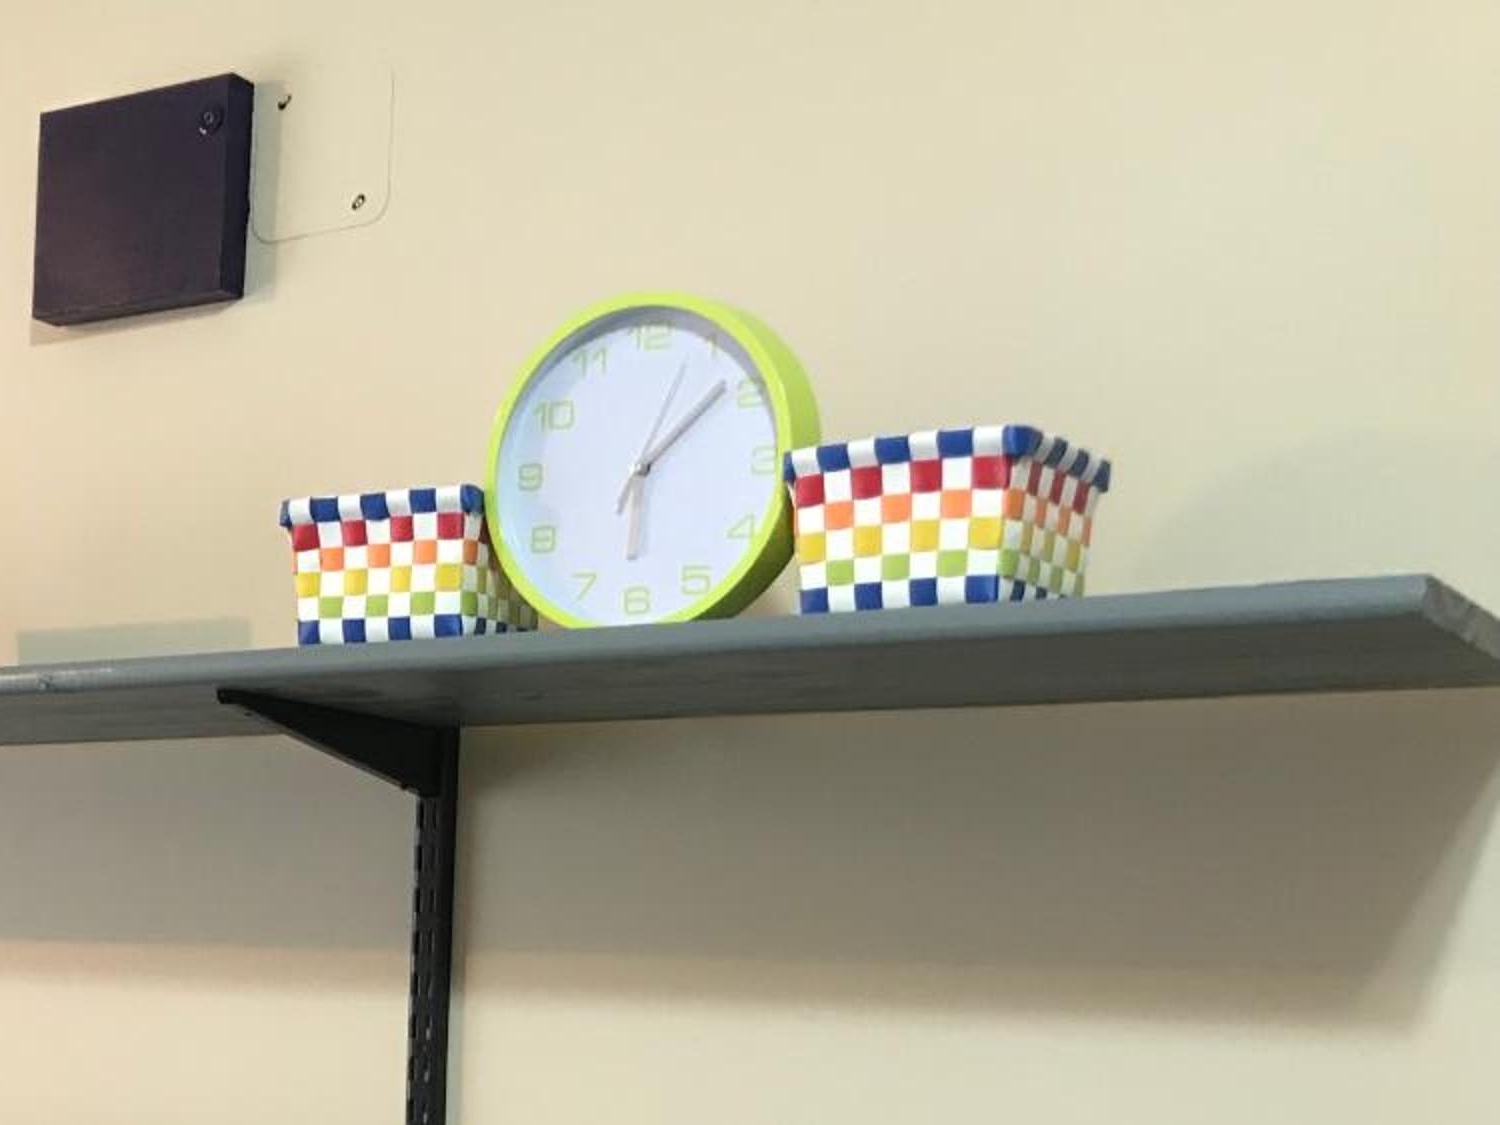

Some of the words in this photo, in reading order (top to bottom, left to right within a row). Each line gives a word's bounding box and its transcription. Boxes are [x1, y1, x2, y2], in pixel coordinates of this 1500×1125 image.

[629, 321, 675, 351] 12
[571, 347, 609, 378] 11
[736, 379, 766, 409] 2
[534, 399, 575, 432] 10
[751, 446, 776, 476] 3
[518, 463, 543, 492] 9
[531, 525, 556, 554] 8
[726, 513, 756, 540] 4
[572, 572, 597, 601] 7
[680, 565, 711, 596] 5
[623, 586, 649, 615] 6
